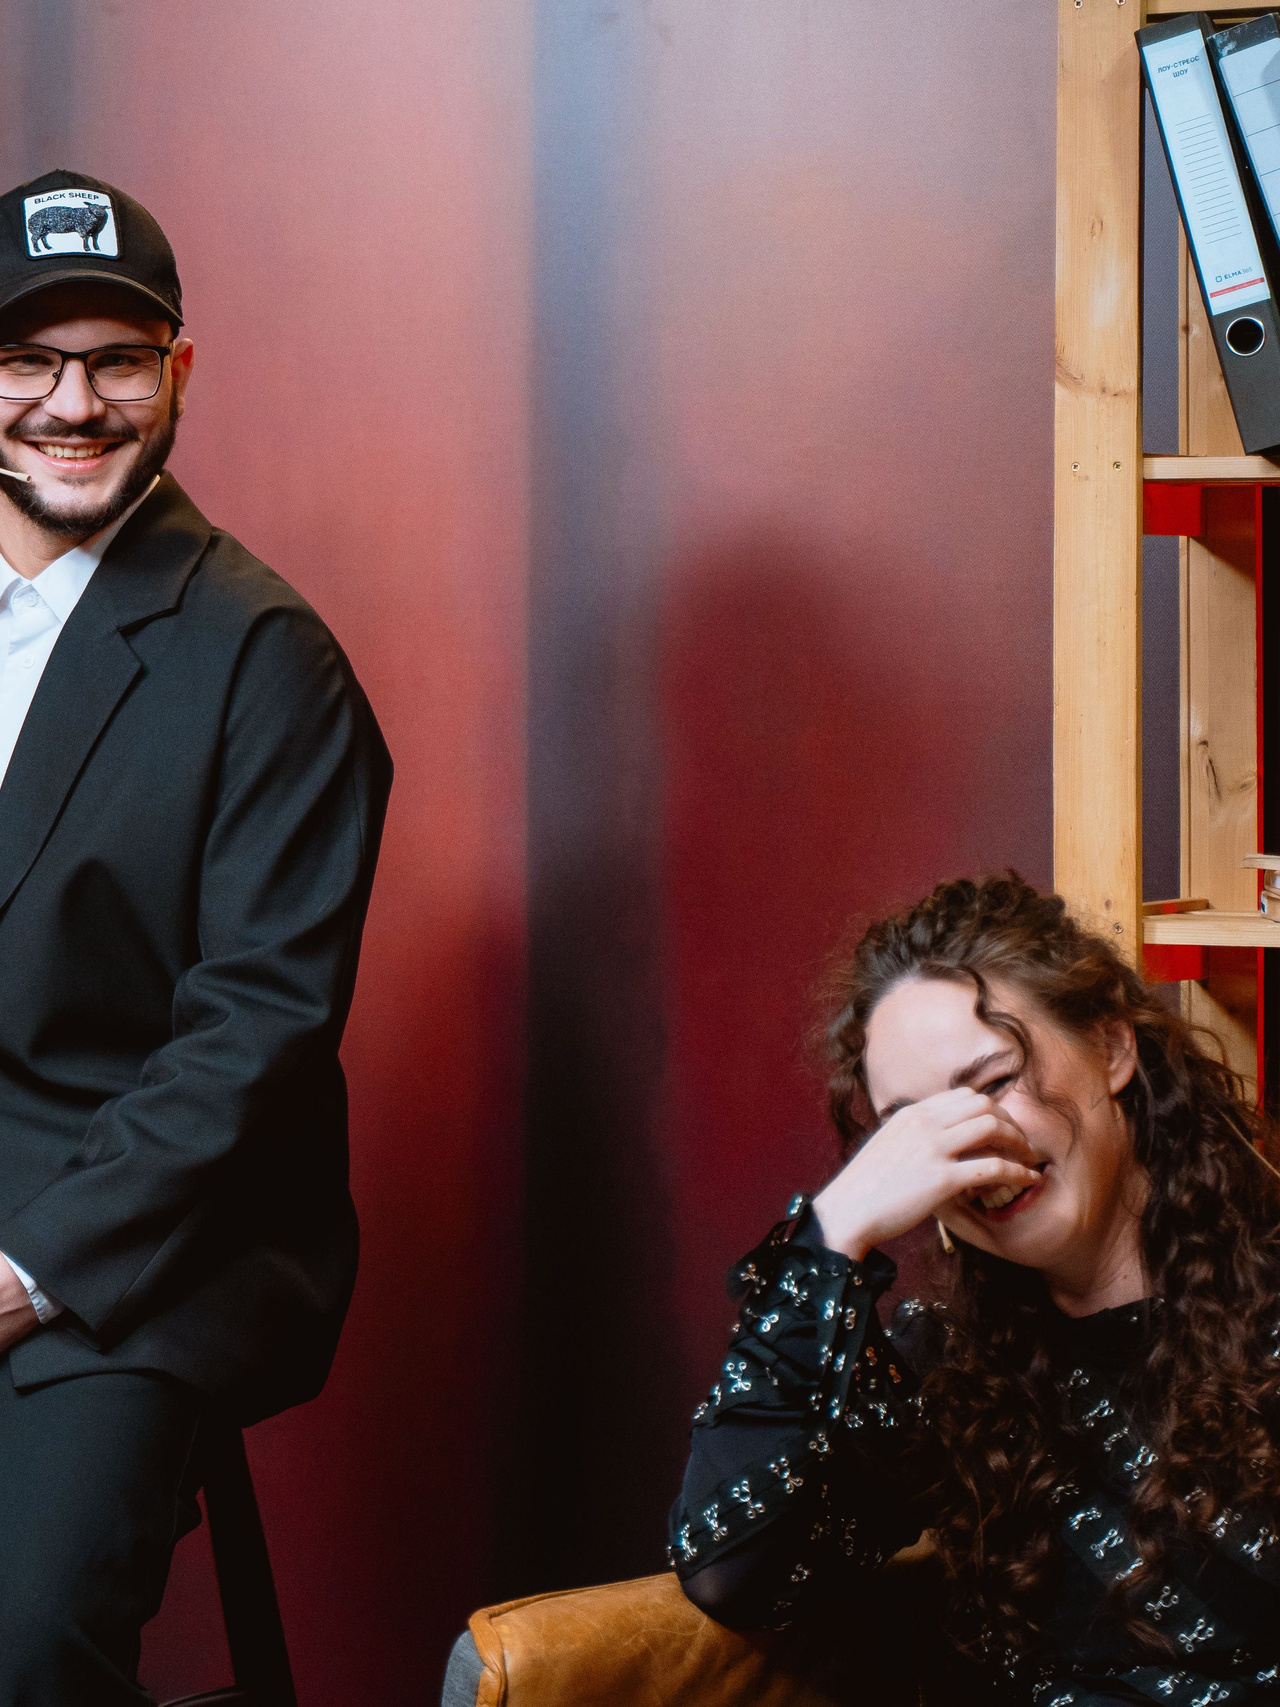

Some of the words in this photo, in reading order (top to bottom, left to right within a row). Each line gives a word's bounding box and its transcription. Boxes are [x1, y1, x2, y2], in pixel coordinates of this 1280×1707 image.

[1157, 56, 1200, 73] ЛОУ-СТРЕСС
[1172, 68, 1189, 78] ШОУ
[34, 193, 66, 204] BLACK
[68, 192, 100, 201] SHEEP
